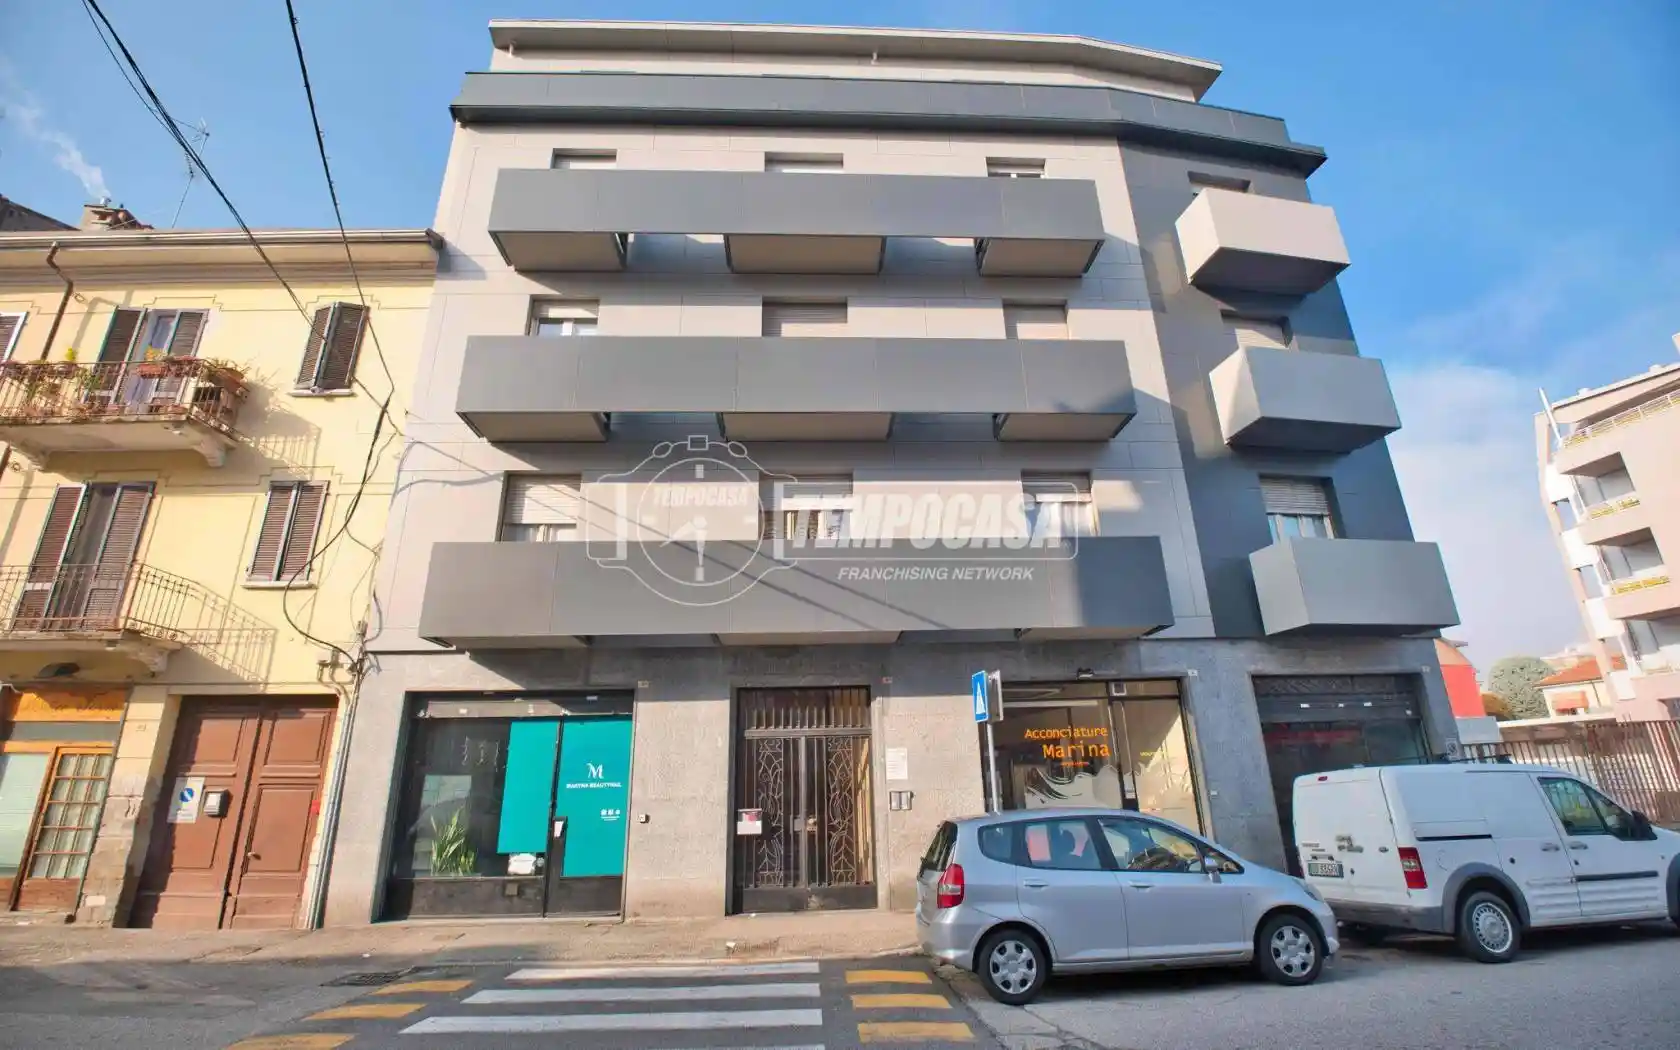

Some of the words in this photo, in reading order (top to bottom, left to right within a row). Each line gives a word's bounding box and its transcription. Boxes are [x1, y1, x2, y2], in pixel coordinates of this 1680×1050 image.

[1024, 725, 1109, 739] Acconciature
[1042, 741, 1110, 758] Marina
[586, 762, 604, 779] M
